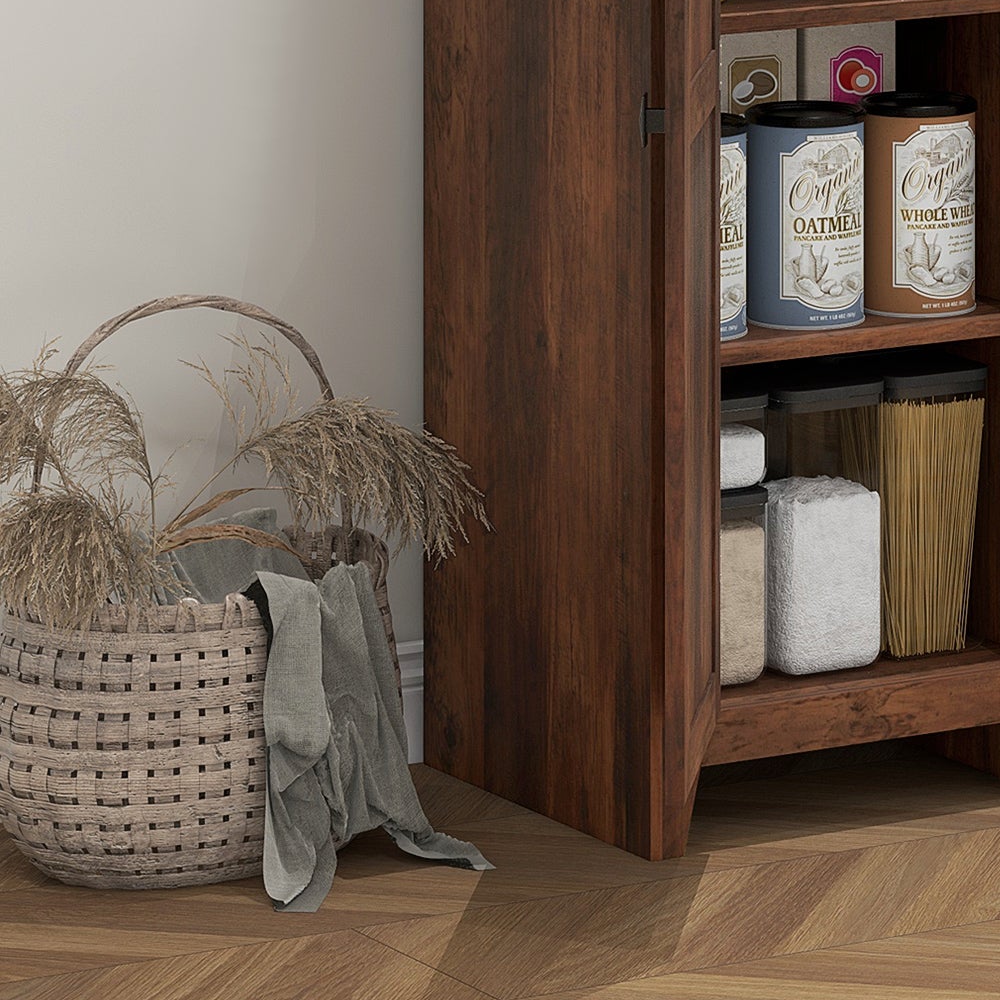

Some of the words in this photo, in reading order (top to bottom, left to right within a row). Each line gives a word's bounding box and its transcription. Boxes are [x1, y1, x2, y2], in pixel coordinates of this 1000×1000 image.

[901, 208, 948, 222] WHOLE
[793, 212, 862, 234] OATMEAL
[794, 234, 823, 242] PANCAKE
[824, 233, 837, 241] AND
